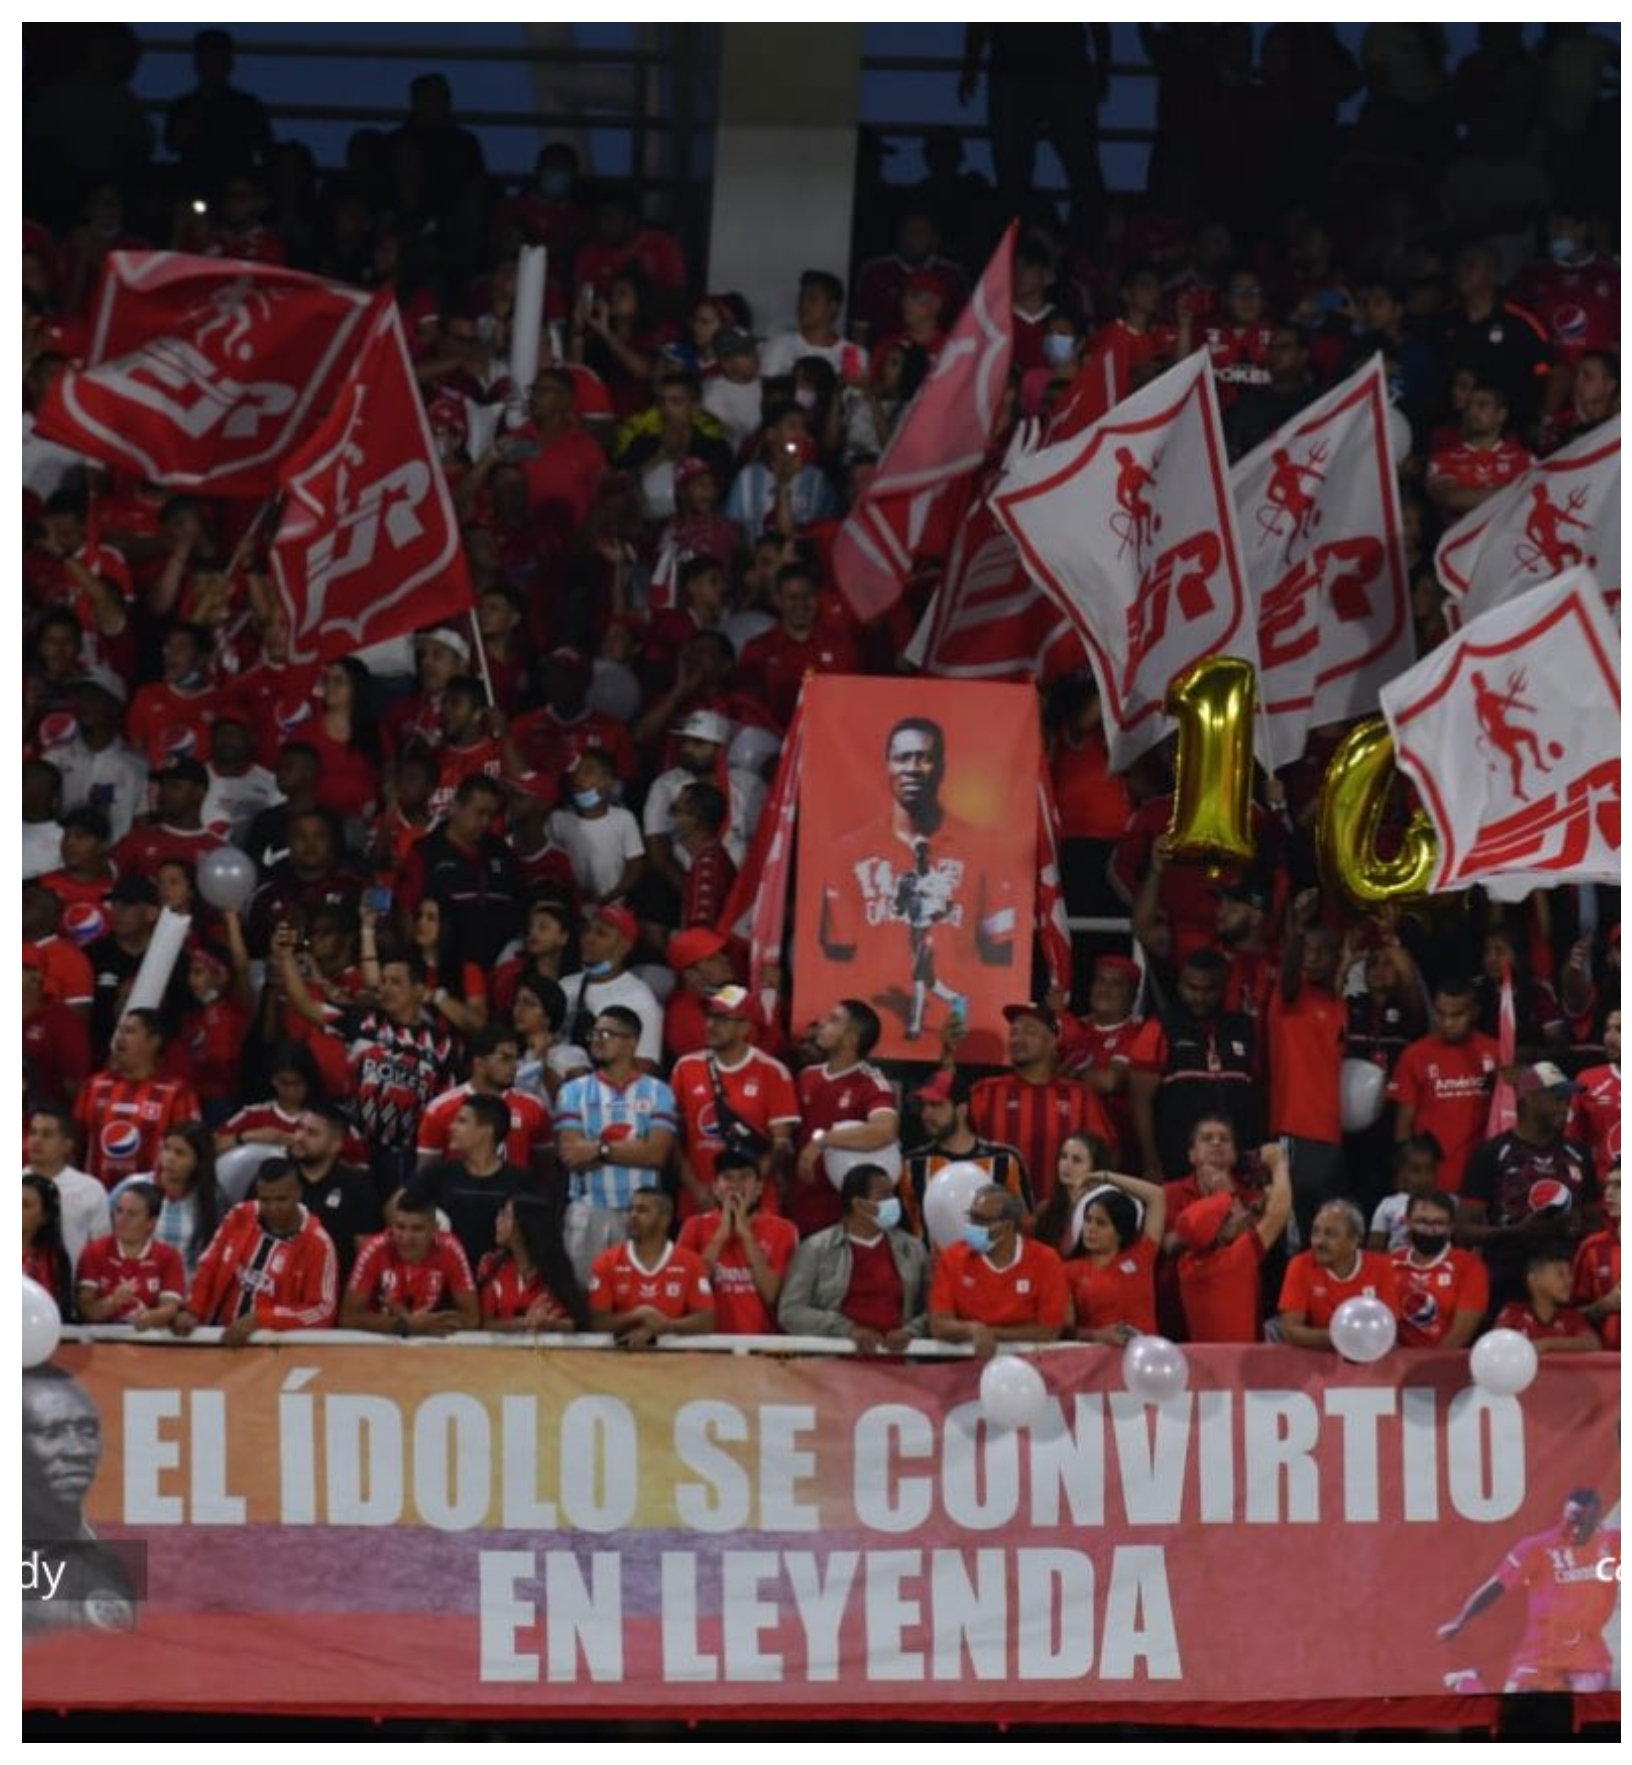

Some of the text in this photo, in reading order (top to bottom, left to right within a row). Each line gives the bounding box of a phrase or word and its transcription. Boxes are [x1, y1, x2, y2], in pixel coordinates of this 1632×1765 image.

[363, 1058, 427, 1099] POKER
[123, 1367, 1526, 1533] EL ÍDOLO SE CONVIRTIO
[479, 1544, 1184, 1683] EN LEYENDA
